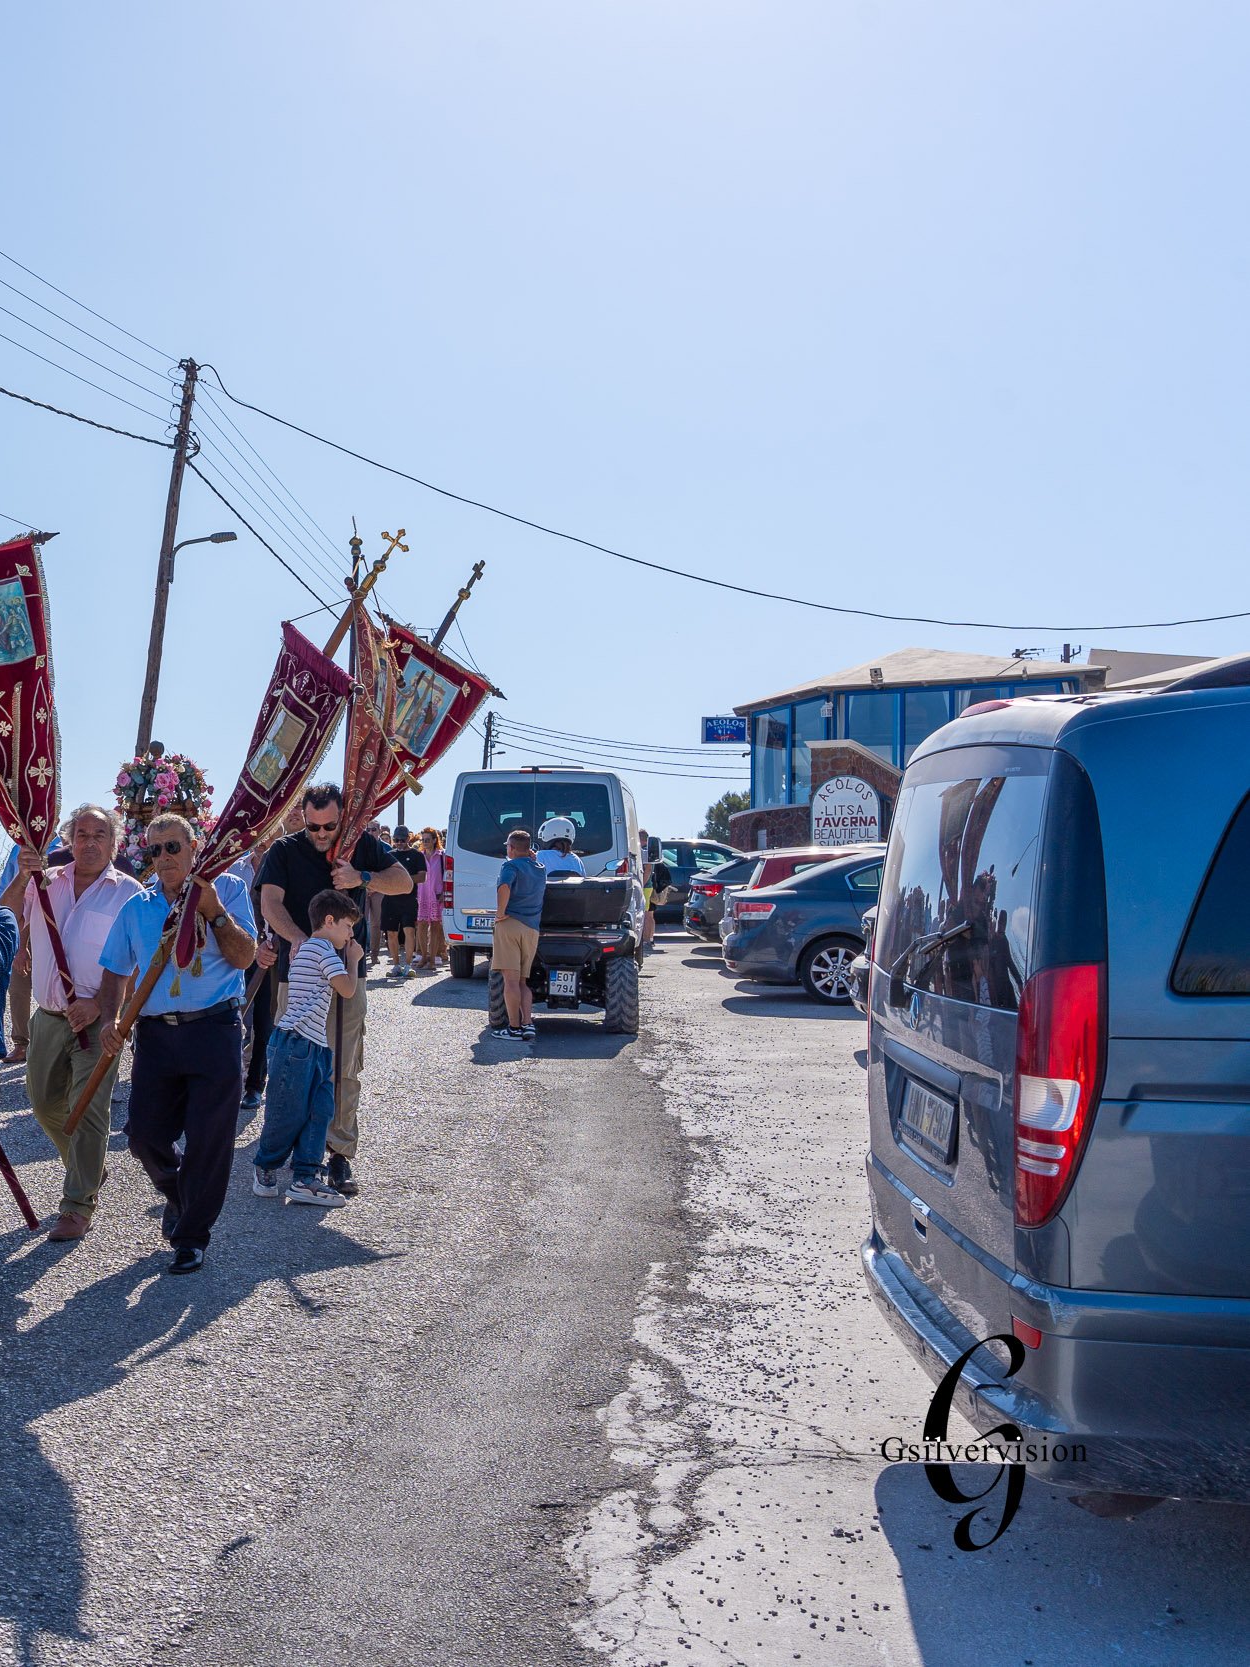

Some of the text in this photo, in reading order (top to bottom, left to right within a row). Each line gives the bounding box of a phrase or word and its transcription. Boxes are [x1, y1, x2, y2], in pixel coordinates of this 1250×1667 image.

[706, 719, 745, 728] AEOLOS
[818, 778, 873, 802] AEOLOS
[814, 815, 878, 828] TAVERNA
[556, 984, 574, 994] 794
